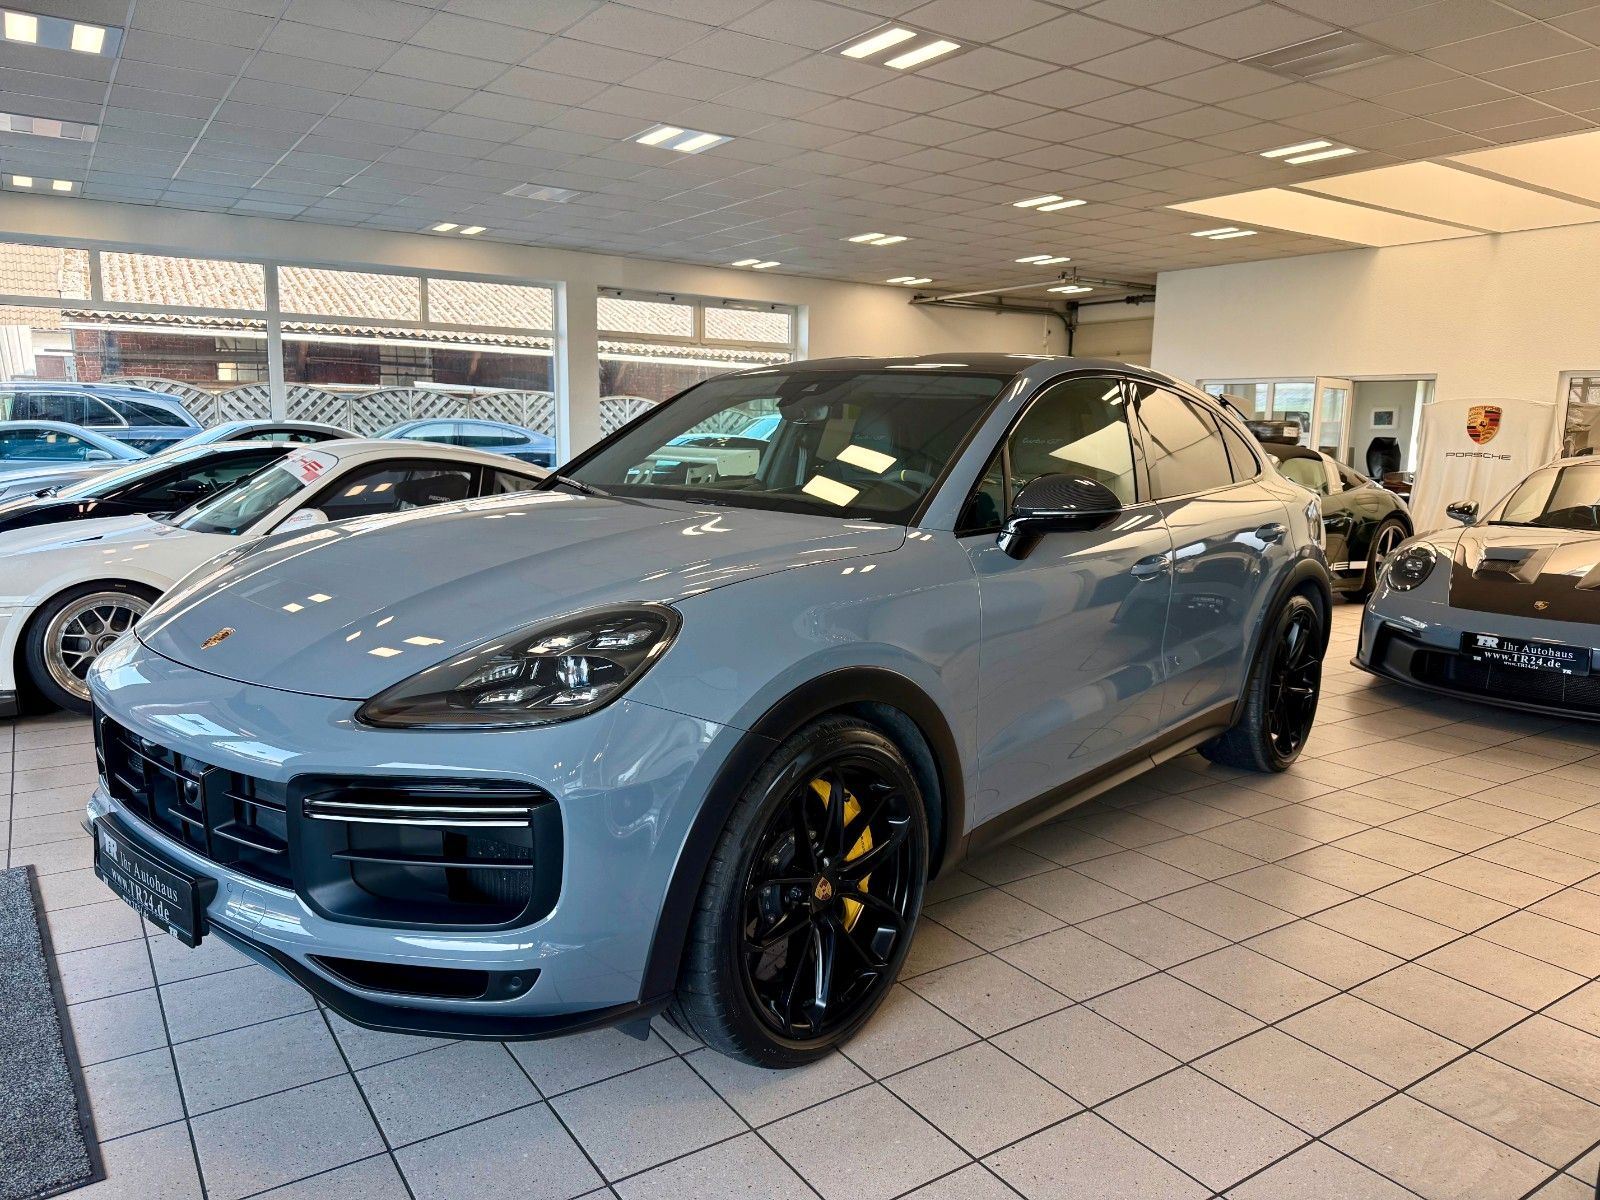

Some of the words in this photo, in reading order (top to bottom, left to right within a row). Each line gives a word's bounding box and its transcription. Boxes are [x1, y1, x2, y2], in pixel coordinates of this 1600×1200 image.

[1445, 452, 1511, 461] PORSCHE
[1503, 641, 1519, 652] Ihr
[1522, 644, 1574, 659] Autohaus
[1484, 651, 1561, 669] www.TR24.de
[1503, 660, 1539, 670] www.TR24.de
[121, 851, 132, 873] Ihr
[134, 863, 178, 902] Autohaus
[111, 868, 170, 921] www.TR24.de
